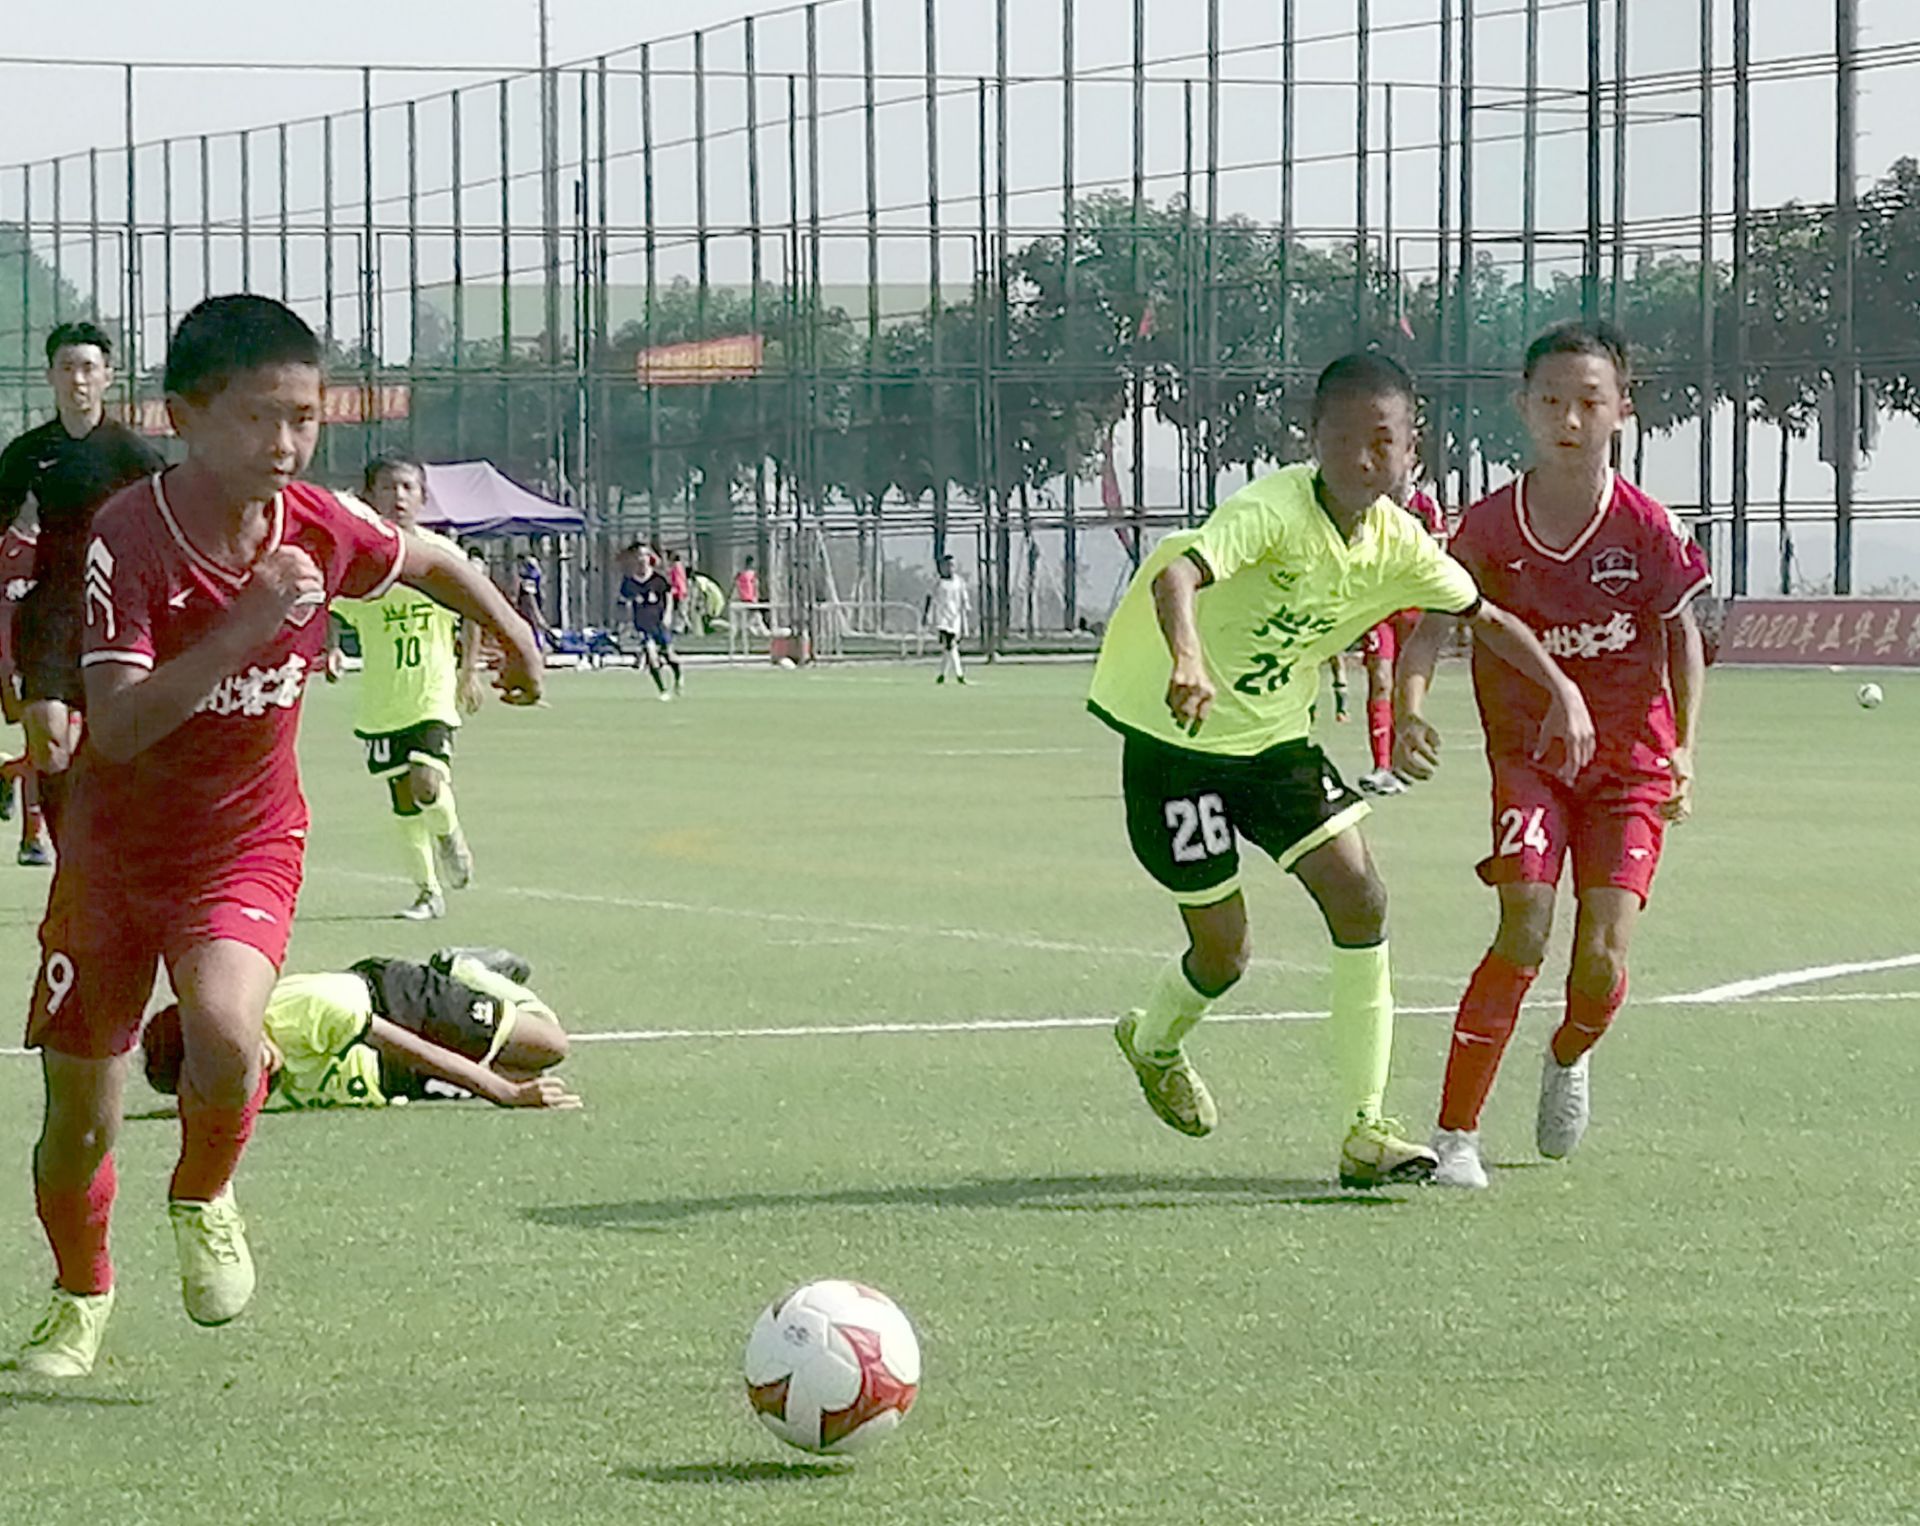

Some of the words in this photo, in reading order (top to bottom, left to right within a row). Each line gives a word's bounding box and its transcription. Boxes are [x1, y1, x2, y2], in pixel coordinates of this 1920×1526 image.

[394, 636, 420, 669] 10
[1165, 793, 1231, 862] 26
[1500, 807, 1549, 855] 24
[46, 951, 75, 1015] 9
